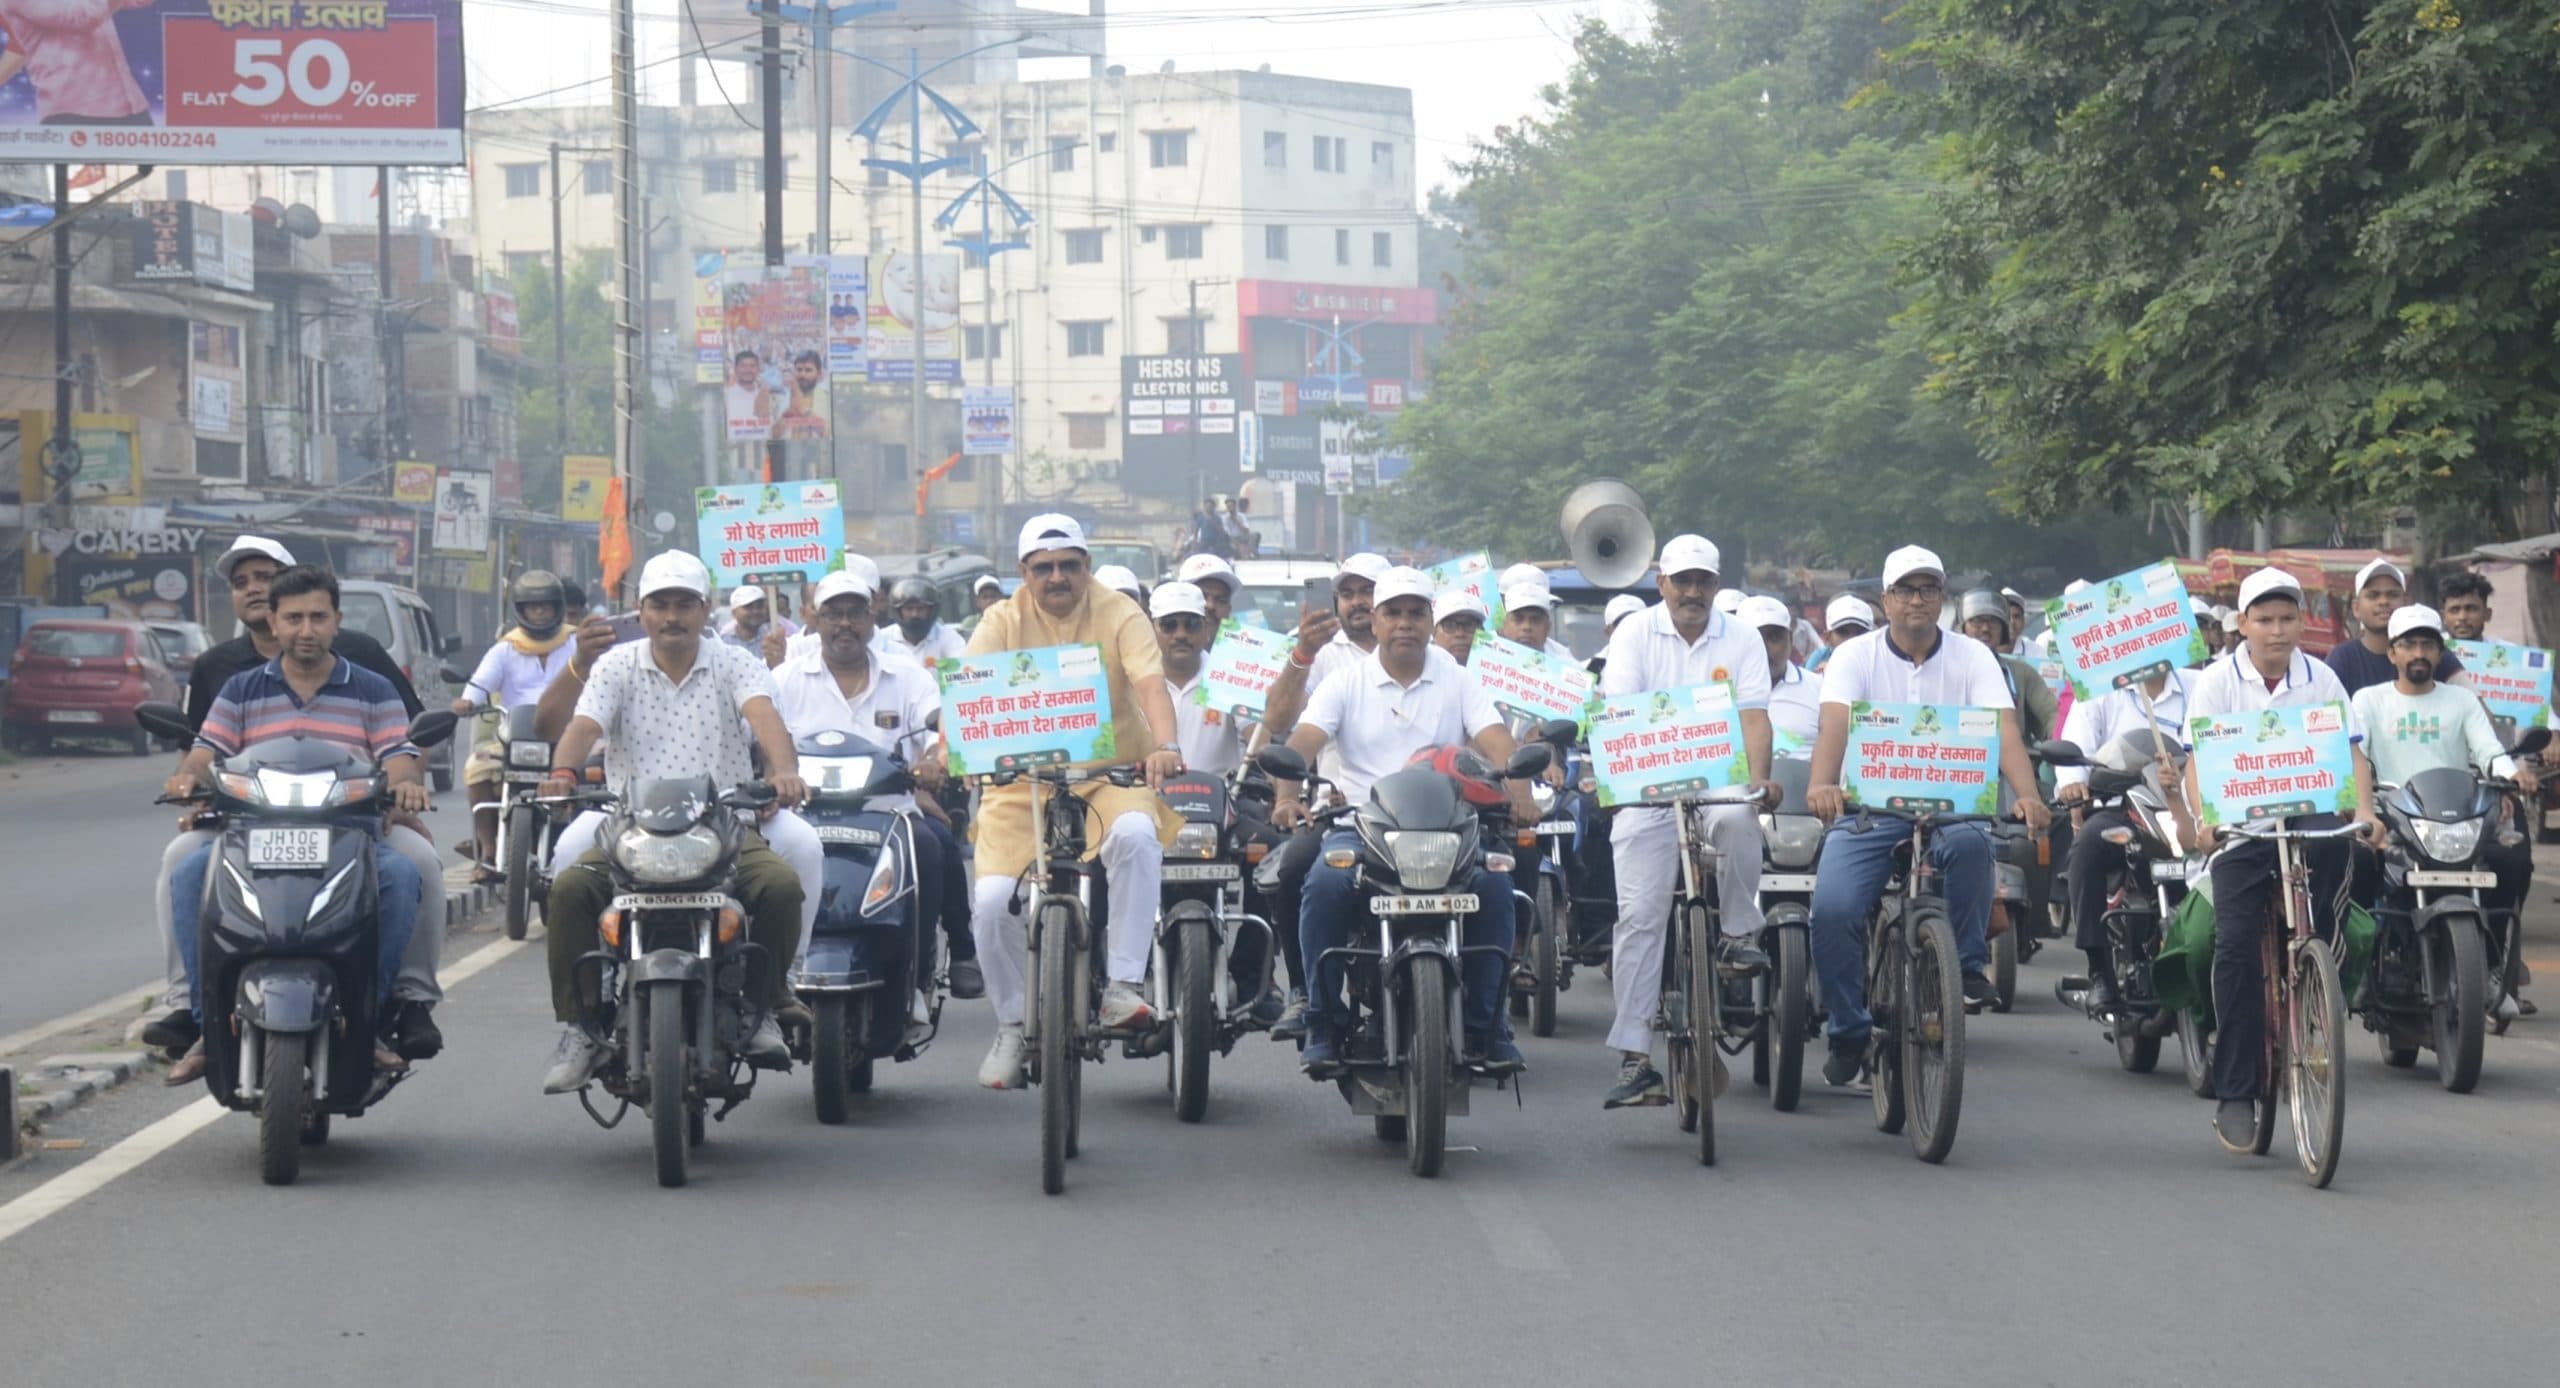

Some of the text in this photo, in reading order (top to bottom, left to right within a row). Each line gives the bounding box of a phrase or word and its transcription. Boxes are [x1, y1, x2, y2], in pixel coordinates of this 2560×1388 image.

[182, 93, 227, 107] FLAT
[382, 94, 416, 107] OFF
[94, 132, 216, 147] 18004102244
[75, 528, 204, 553] CAKERY
[724, 517, 820, 544] जो पेड़ लगाएंगे
[720, 548, 736, 568] वो
[739, 546, 780, 566] जीवन
[2071, 601, 2179, 651] प्रकृति से जो करे प्यार
[2076, 652, 2091, 670] वो
[2093, 646, 2111, 665] करे
[2112, 636, 2145, 660] इसका
[957, 688, 1096, 722] प्रकृति का करें सम्मान
[961, 713, 1097, 742] तभी बनेगा देश महान
[1604, 721, 1729, 757] प्रकृति का करें सम्मान
[1608, 743, 1731, 775] तभी बनेगा देश महान
[1861, 740, 1987, 763] प्रकृति का करें सम्मान
[2233, 745, 2315, 773] पौधा लगाओ
[1861, 764, 1985, 785] तभी बनेगा देश महान
[2223, 775, 2292, 799] ऑक्सीजन
[264, 831, 318, 845] JH10C
[1374, 899, 1391, 910] JH
[1416, 899, 1436, 910] AM
